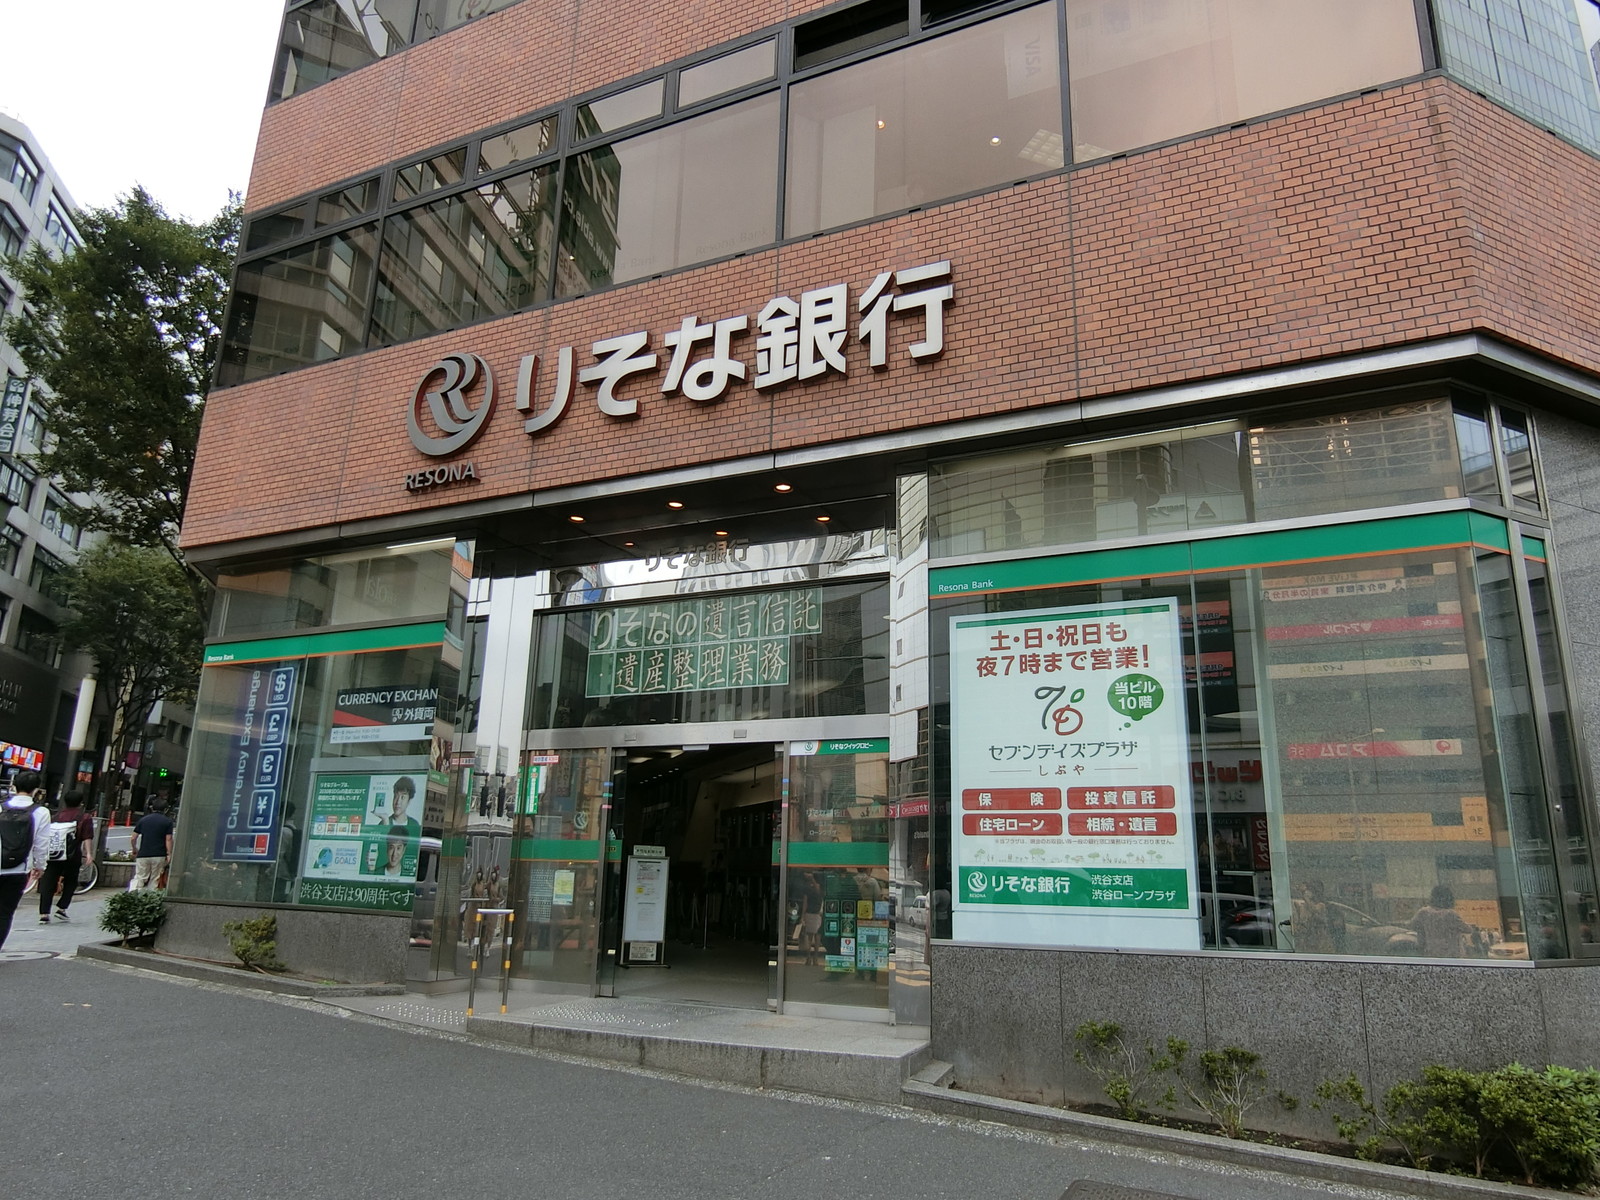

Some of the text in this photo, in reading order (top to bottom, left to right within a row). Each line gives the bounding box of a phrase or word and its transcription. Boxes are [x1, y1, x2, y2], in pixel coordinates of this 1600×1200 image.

[1024, 37, 1042, 78] VISA
[516, 259, 955, 436] りそな銀行
[404, 460, 480, 493] RESONA
[645, 538, 750, 572] りそな銀行
[938, 579, 994, 592] Resona Bank
[592, 588, 821, 650] りそなの遺言信託
[990, 622, 1128, 652] 土・日・祝日も
[1114, 681, 1157, 696] 当ビル
[338, 690, 394, 706] CURRENCY
[1118, 695, 1153, 711] 10階
[240, 670, 261, 746] Exchange
[404, 706, 437, 722] 外貨両
[1038, 764, 1086, 777] しぶや
[227, 750, 250, 830] Currency
[1085, 790, 1157, 806] 投資信託
[979, 816, 1157, 832] 住宅ローン 相続・遺言
[334, 857, 358, 865] GOALS
[991, 874, 1134, 895] りそな銀行 渋谷支店
[300, 882, 415, 906] 渋谷支店は90周年です
[1091, 888, 1177, 902] 渋谷ローンプラザ
